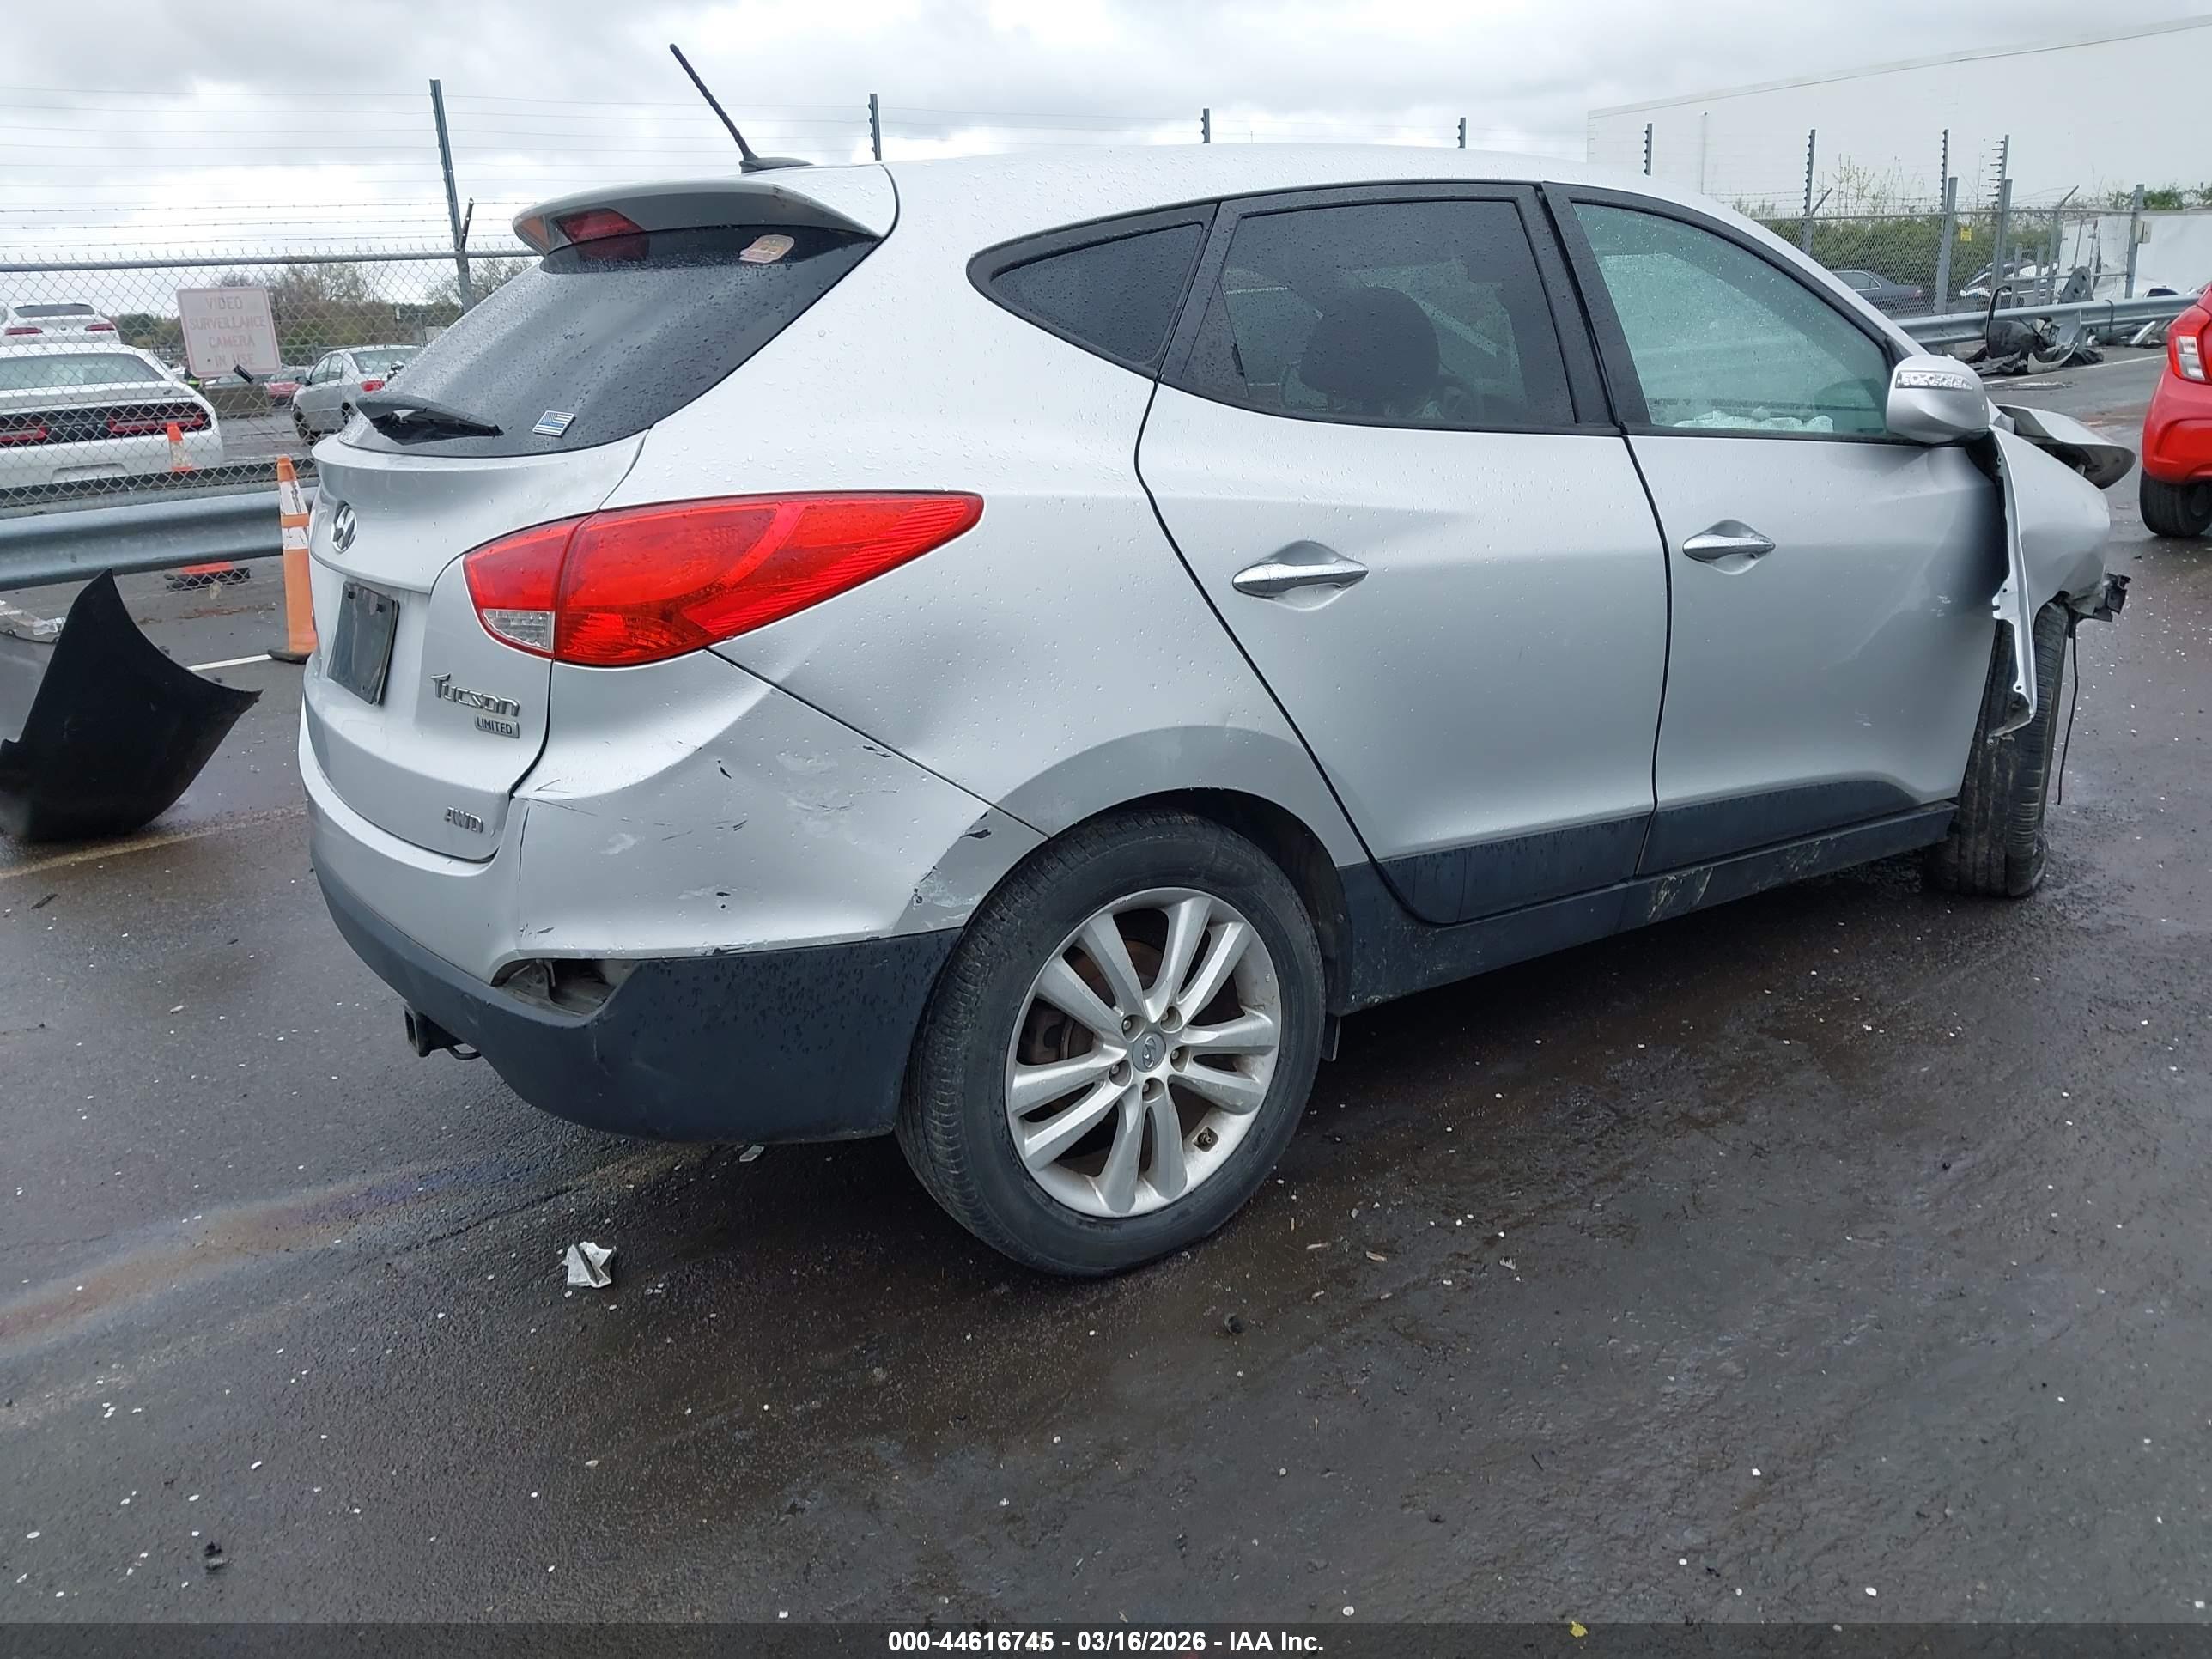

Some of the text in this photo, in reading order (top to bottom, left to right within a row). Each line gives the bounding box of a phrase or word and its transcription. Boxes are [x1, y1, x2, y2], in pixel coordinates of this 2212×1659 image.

[205, 296, 243, 310] VIDEO
[189, 316, 266, 331] SURVEILLANCE
[208, 335, 256, 349] CAMERA
[214, 353, 256, 368] IN USE
[430, 672, 520, 717] Tucson
[477, 716, 513, 735] LIMITED
[445, 806, 483, 833] AWD
